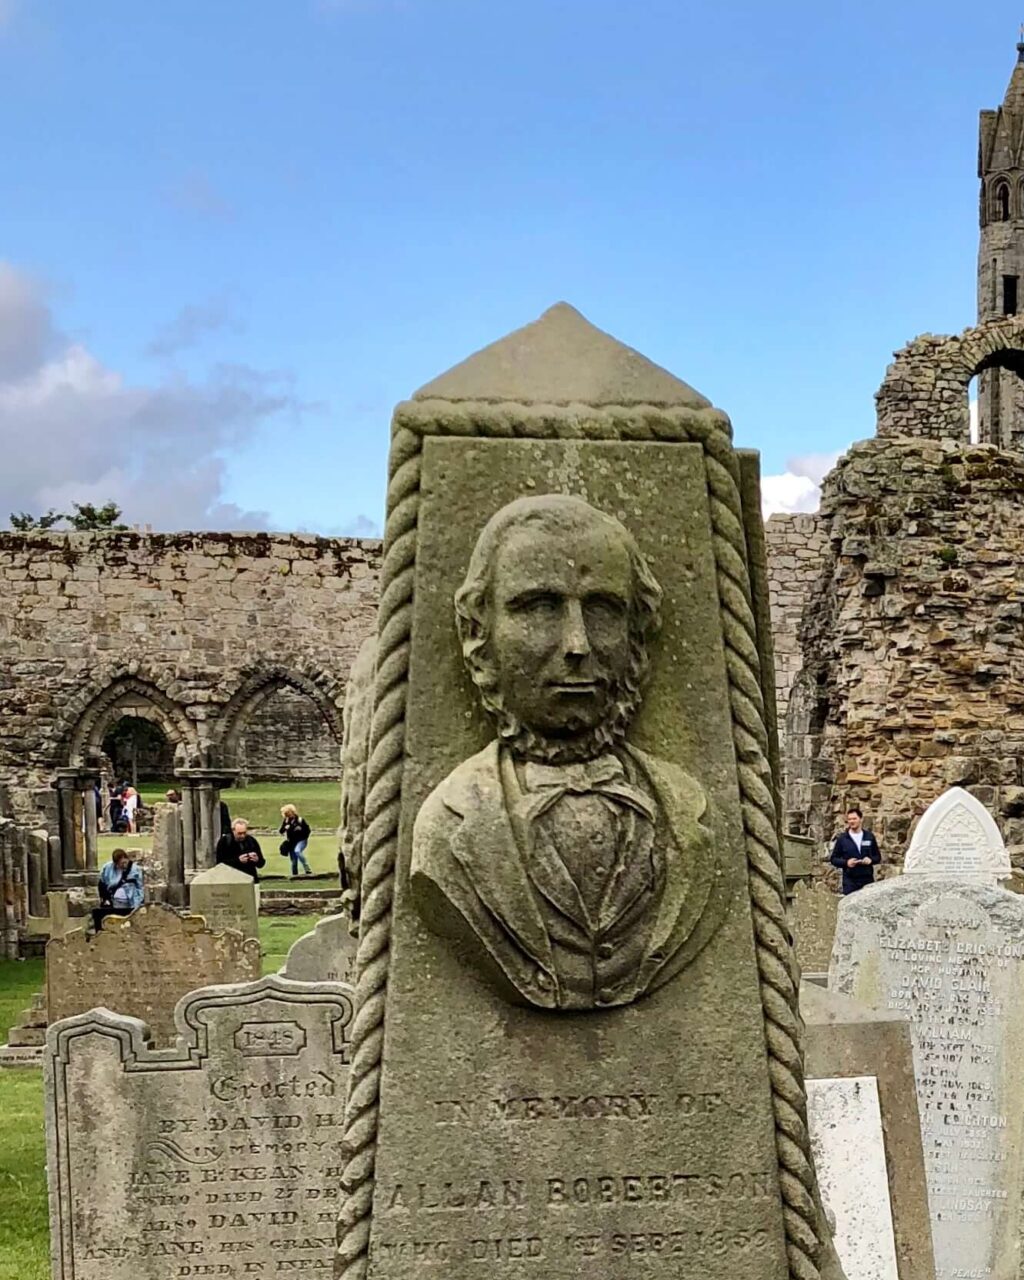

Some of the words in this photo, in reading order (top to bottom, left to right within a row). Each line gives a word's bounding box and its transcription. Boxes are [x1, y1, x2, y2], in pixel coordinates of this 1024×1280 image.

[904, 952, 942, 963] LOVING
[902, 976, 942, 989] DAVID
[211, 1071, 336, 1101] Erected
[434, 1100, 475, 1124] IN
[492, 1094, 660, 1121] MEMORY
[676, 1093, 722, 1116] OF
[159, 1118, 197, 1133] BY
[207, 1115, 302, 1131] DAVID
[230, 1141, 327, 1155] MEMORY
[126, 1169, 191, 1185] JANE
[206, 1190, 263, 1204] DIED
[387, 1181, 526, 1212] ALLAN
[545, 1172, 772, 1208] ROBERTSON
[142, 1219, 197, 1232] ALSO
[83, 1247, 129, 1261] AND
[219, 1241, 254, 1253] HIS
[470, 1237, 545, 1262] DIED
[177, 1263, 231, 1276] DIED
